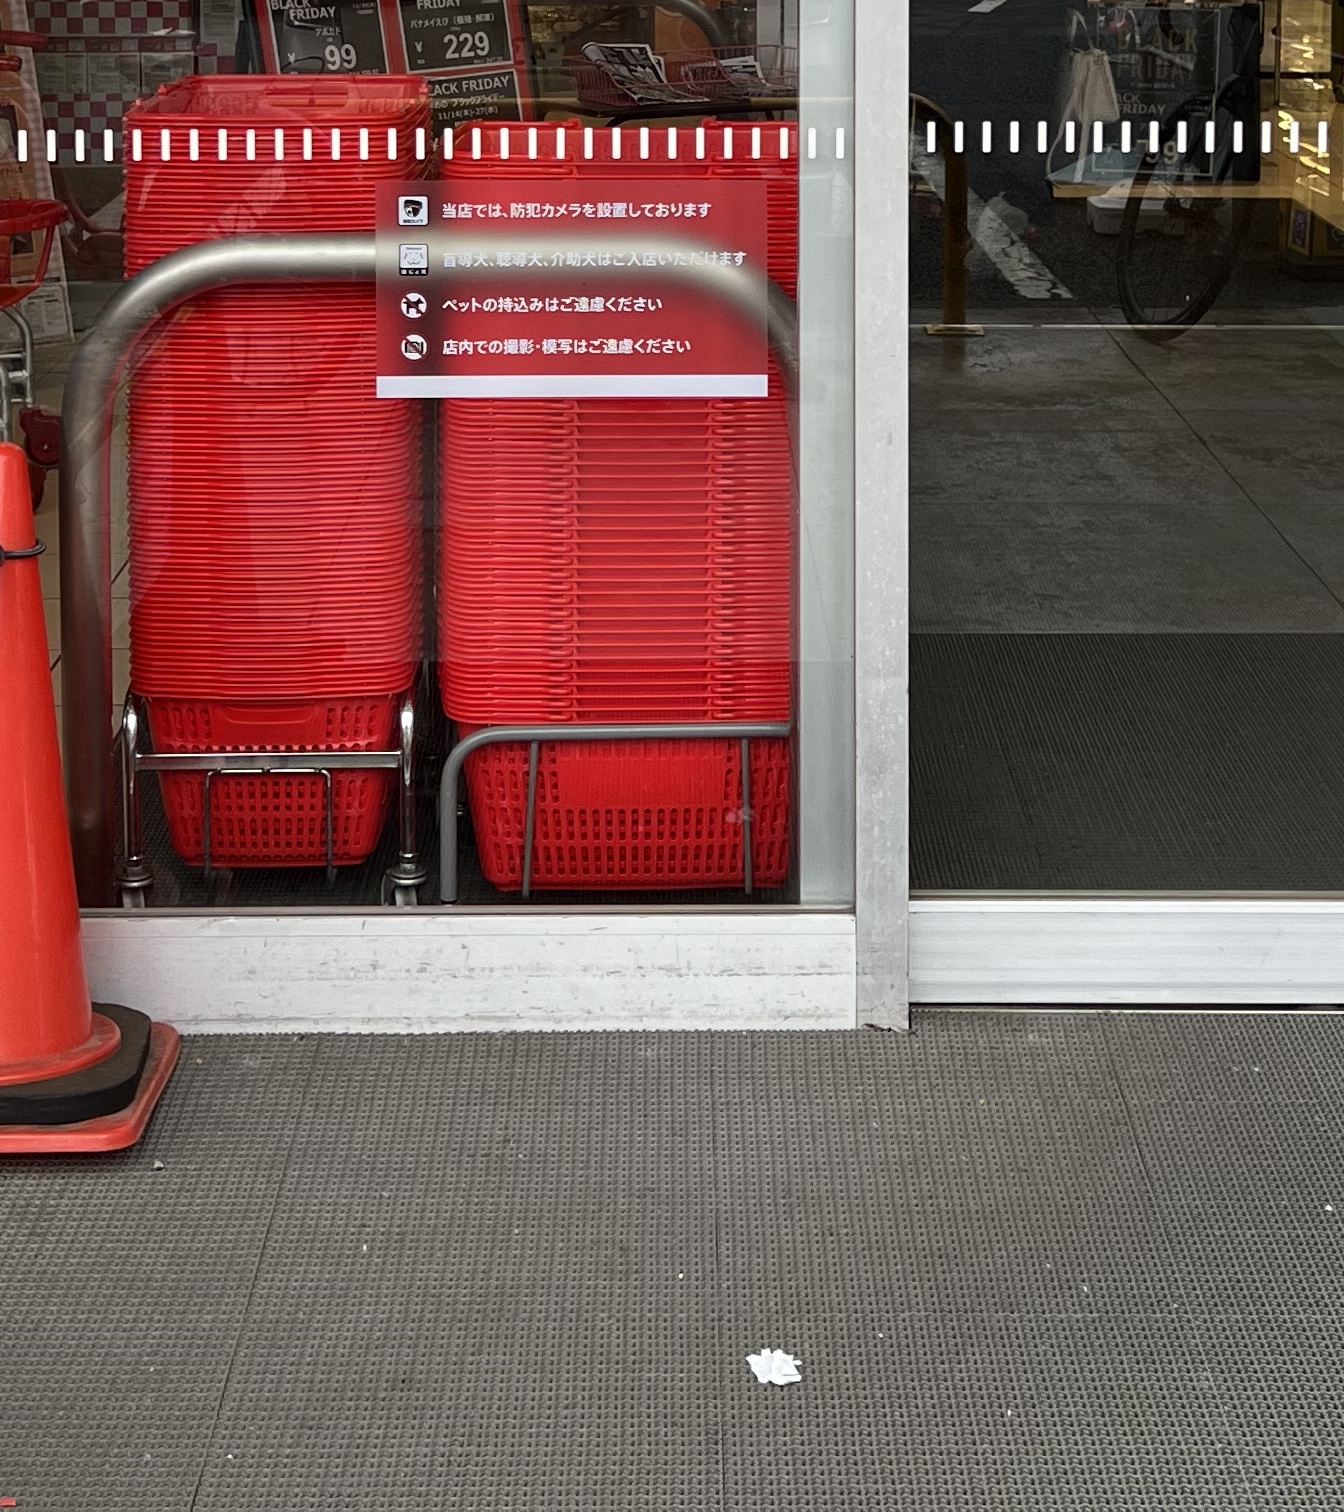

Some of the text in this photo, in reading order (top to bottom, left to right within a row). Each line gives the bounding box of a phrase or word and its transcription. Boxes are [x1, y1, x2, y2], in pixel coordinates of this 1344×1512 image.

[290, 6, 336, 21] FRIDAY
[443, 31, 490, 60] 229
[324, 43, 356, 71] 99
[428, 76, 511, 97] LACK FRIDAY
[441, 201, 712, 219] 当店では、防犯カメラを設置しております
[442, 249, 747, 269] 盲導犬、聴導犬、介助犬はご入店いただけます
[441, 297, 663, 314] ペットの持込みはご遠慮ください
[442, 338, 691, 355] 店内での撮影・模写はご遠慮ください
